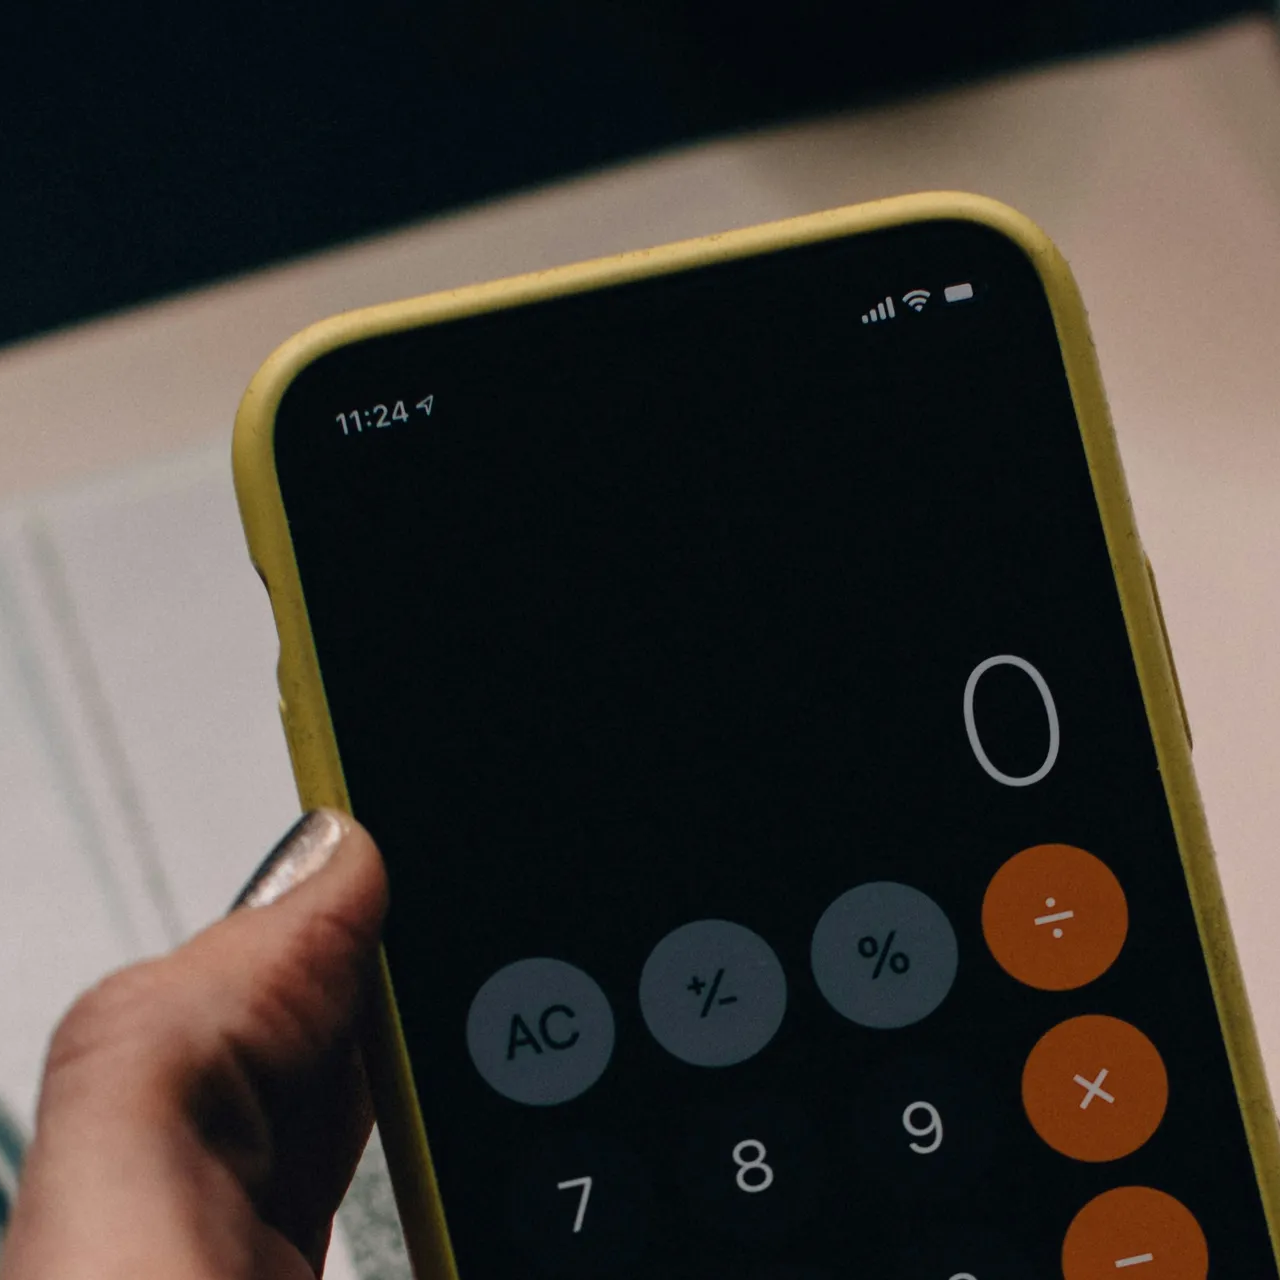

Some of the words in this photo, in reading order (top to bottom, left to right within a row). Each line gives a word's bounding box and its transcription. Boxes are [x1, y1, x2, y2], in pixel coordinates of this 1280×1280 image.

[334, 398, 410, 437] 11:24
[963, 654, 1060, 787] 0
[505, 1003, 581, 1062] AC
[856, 929, 912, 981] %
[556, 1175, 594, 1234] 7
[731, 1138, 775, 1194] 8
[901, 1100, 944, 1155] 9
